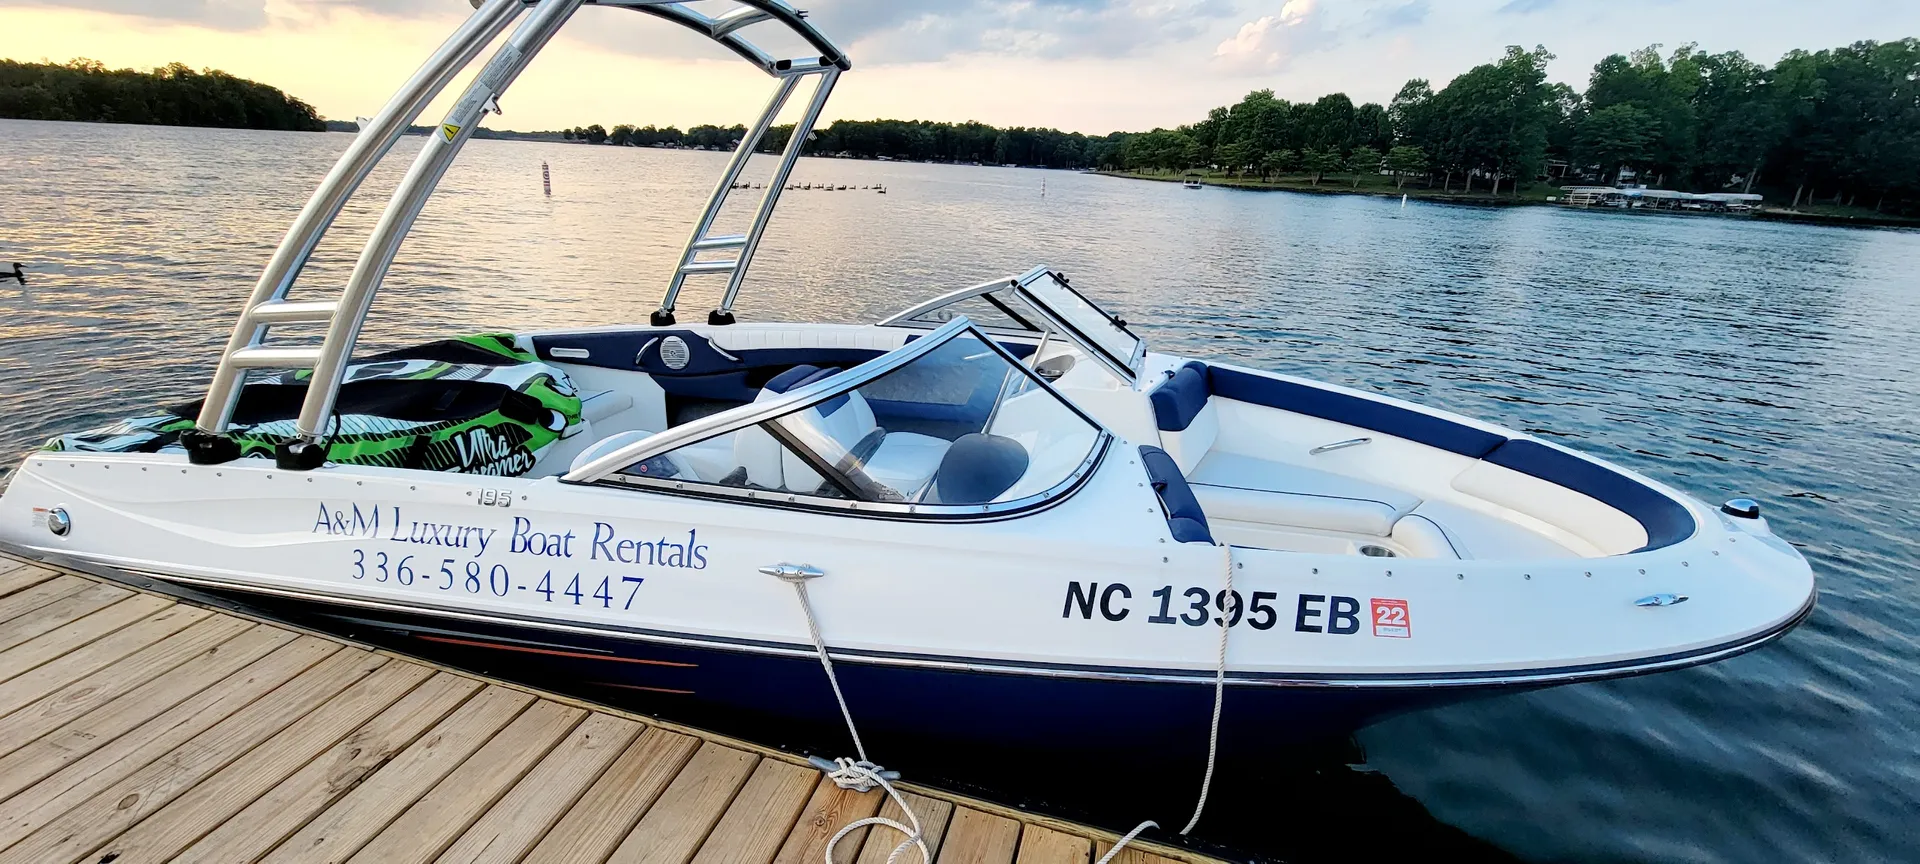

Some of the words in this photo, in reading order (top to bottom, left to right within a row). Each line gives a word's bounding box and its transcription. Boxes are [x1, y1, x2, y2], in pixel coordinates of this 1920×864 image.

[455, 428, 511, 467] Ultra
[477, 488, 512, 507] 195
[312, 501, 379, 538] A&M
[390, 506, 497, 558] Luxury
[508, 516, 576, 558] Boat
[590, 521, 709, 570] Rentals
[352, 549, 644, 610] 336-580-4447
[1062, 581, 1132, 621] NC
[1147, 585, 1277, 630] 1395
[1295, 594, 1360, 634] EB
[1376, 606, 1406, 625] 22
